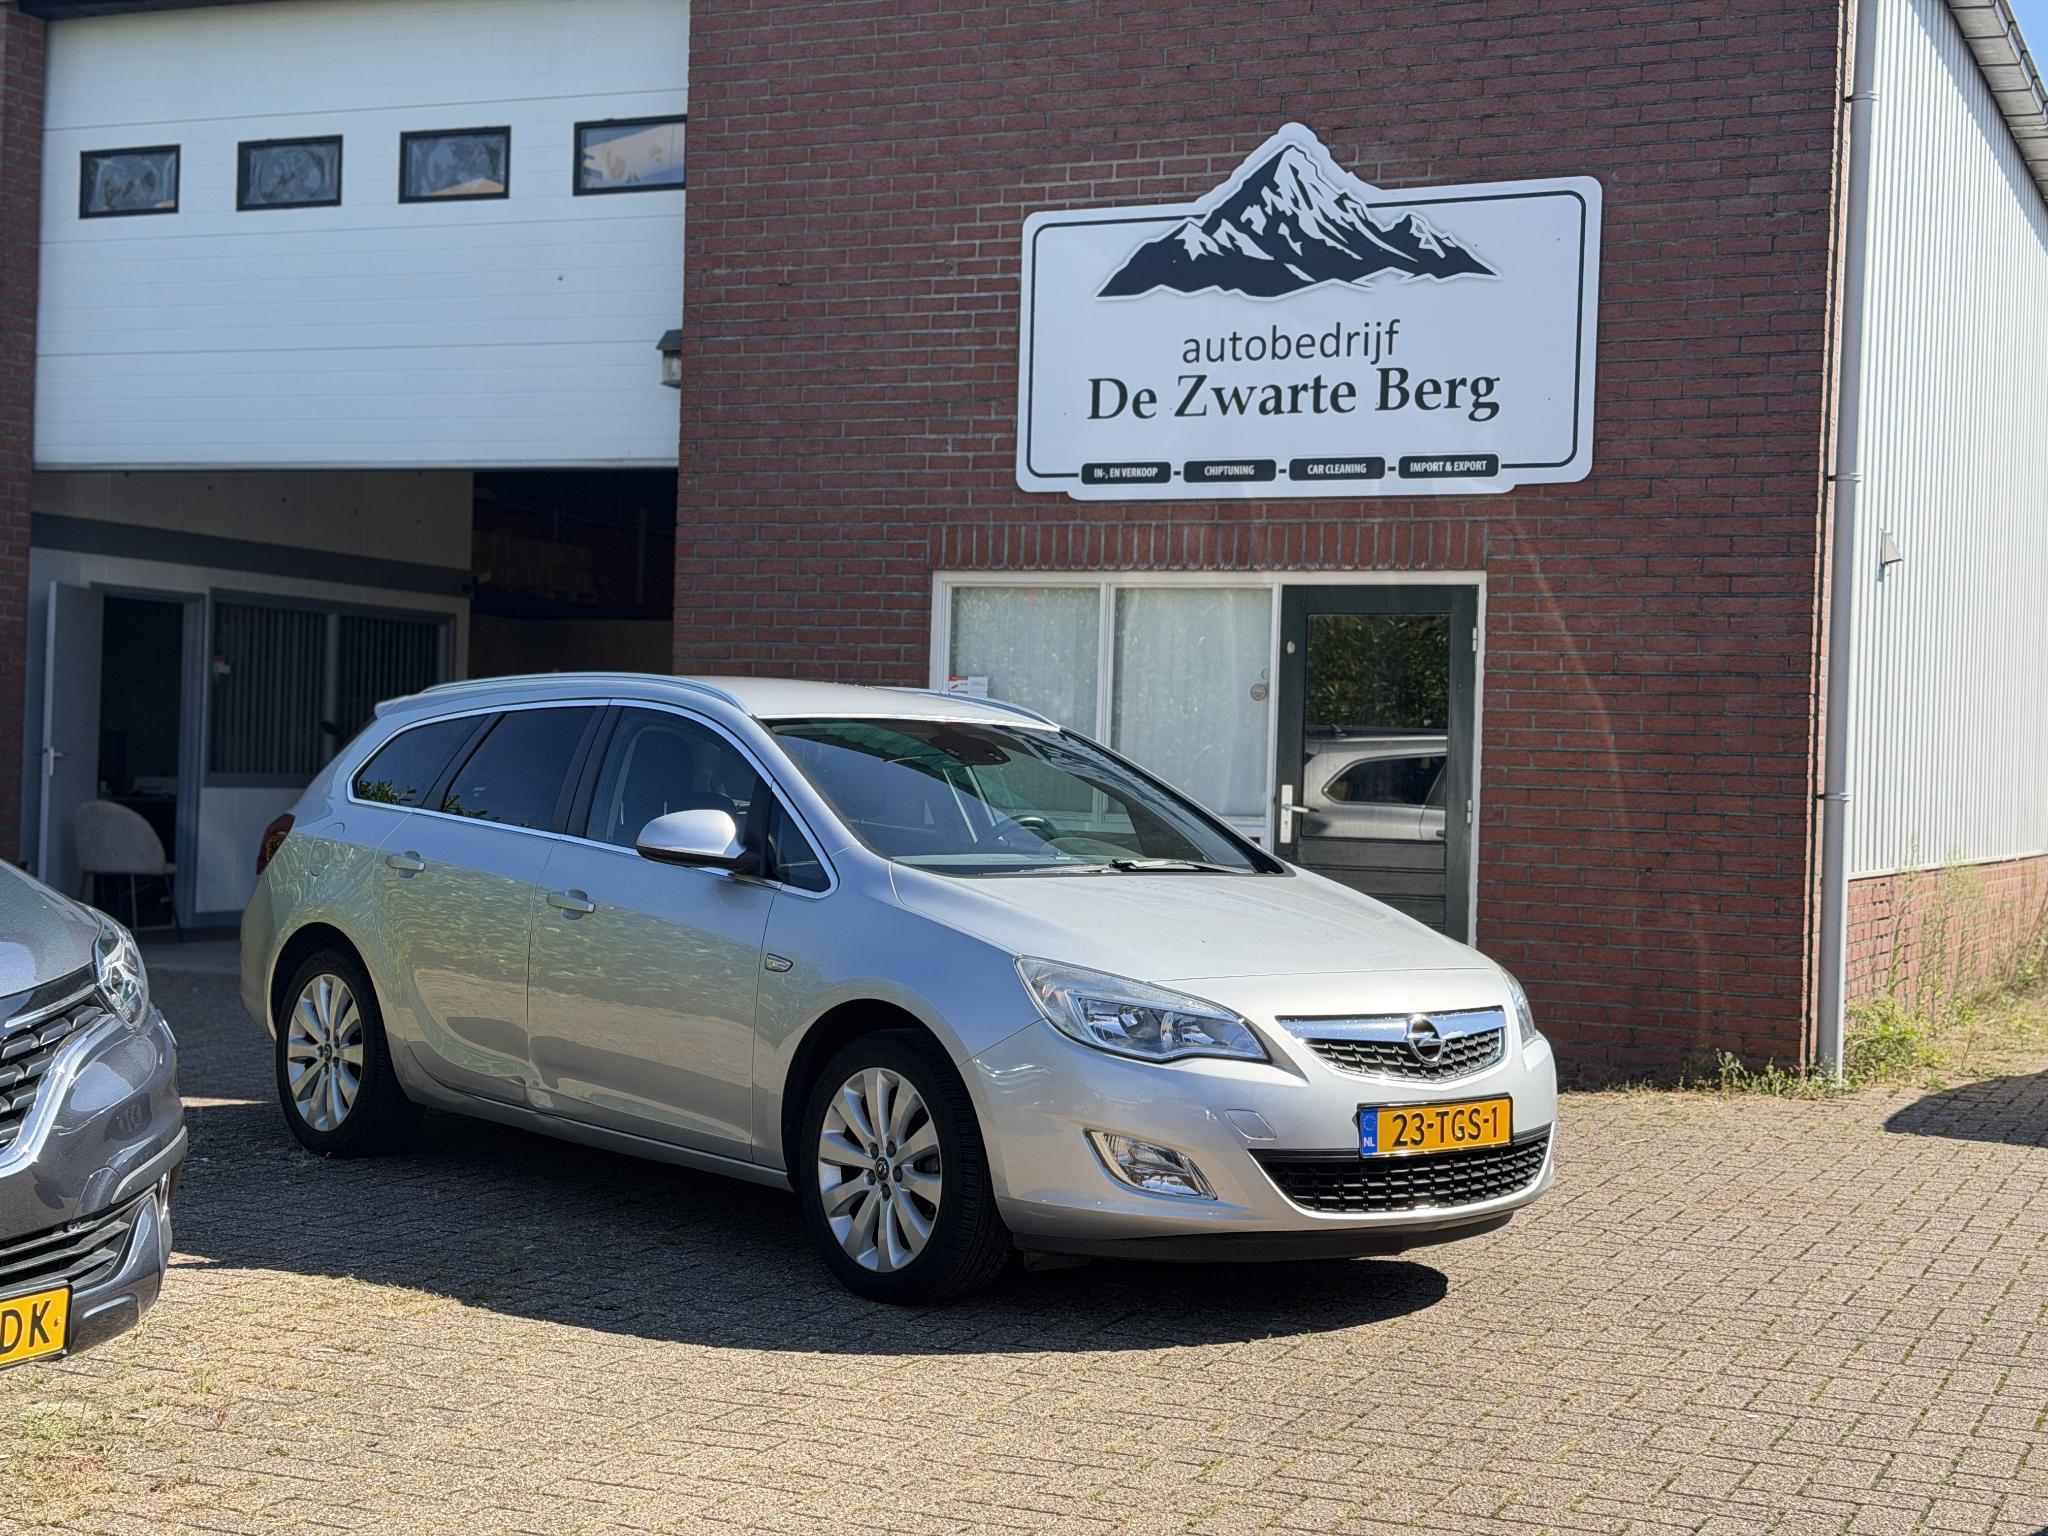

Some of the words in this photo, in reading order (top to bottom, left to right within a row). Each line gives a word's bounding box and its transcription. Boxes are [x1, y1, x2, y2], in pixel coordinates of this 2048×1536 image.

[1182, 318, 1401, 365] autobedrijf
[1087, 377, 1157, 420] De
[1174, 374, 1357, 417] Zwarte
[1375, 367, 1501, 422] Berg
[1109, 467, 1121, 478] EN
[1121, 466, 1158, 478] VERKOOP
[1204, 464, 1255, 476] CHIPTUNING
[1307, 464, 1325, 475] CAR
[1325, 463, 1367, 475] CLEANING
[1409, 462, 1444, 473] IMPORT
[1444, 461, 1453, 472] &
[1453, 460, 1488, 472] EXPORT
[1363, 1137, 1376, 1148] NL
[1391, 1106, 1498, 1148] 23-TGS-1
